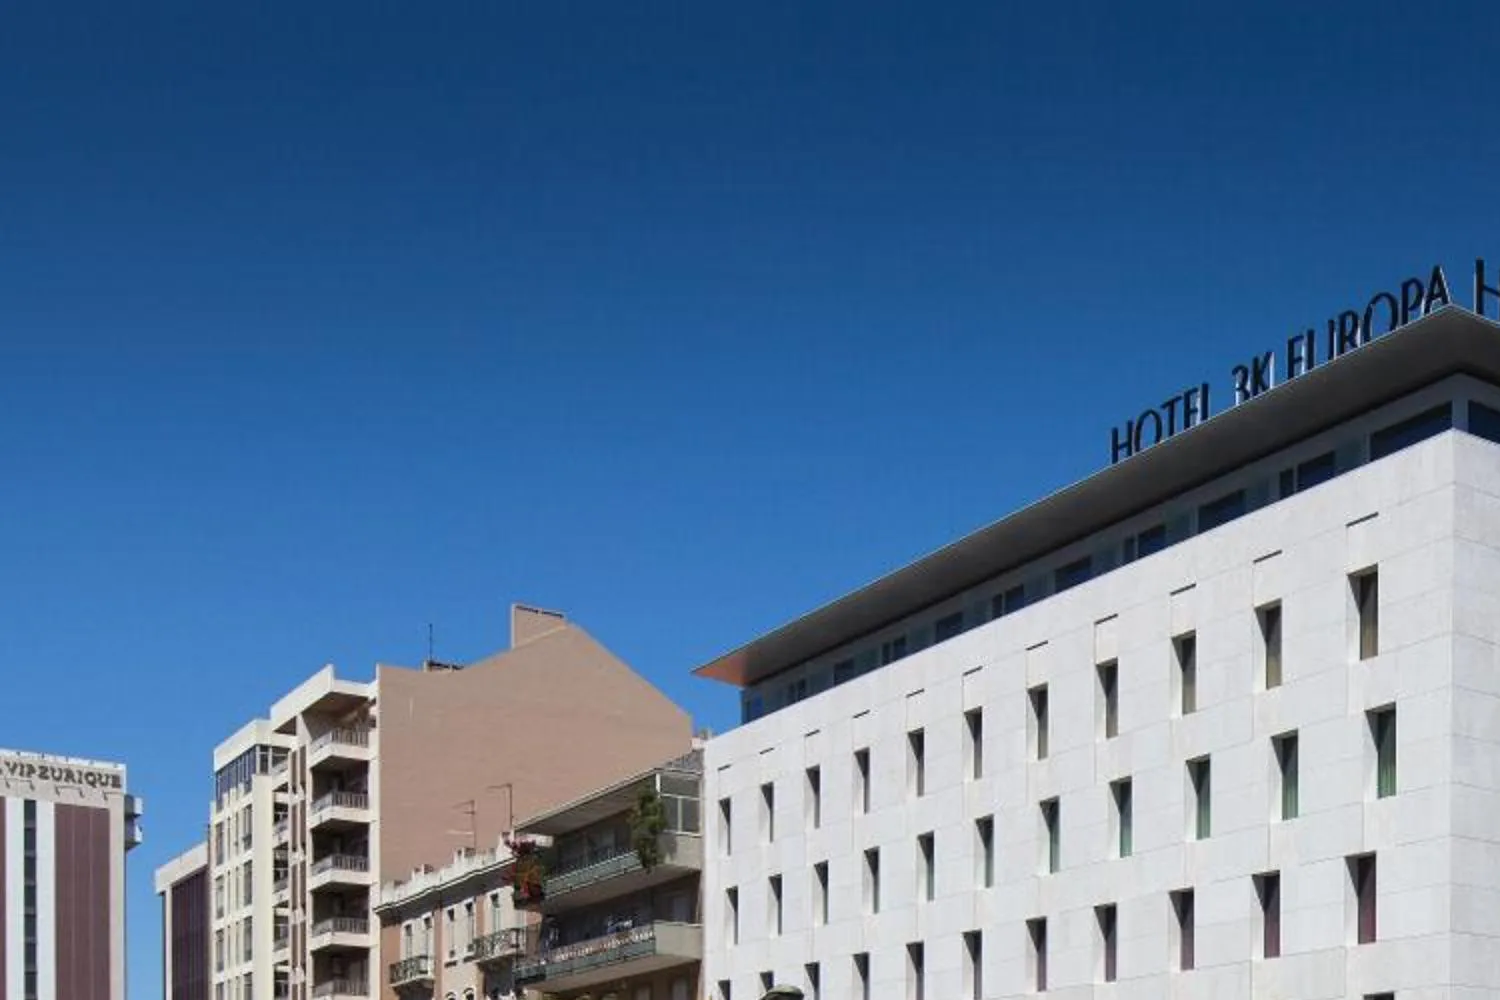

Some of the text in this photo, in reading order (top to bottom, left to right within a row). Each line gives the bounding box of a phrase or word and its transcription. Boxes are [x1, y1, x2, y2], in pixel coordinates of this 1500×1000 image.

[1111, 264, 1452, 464] HOTEL 3K EUROPA
